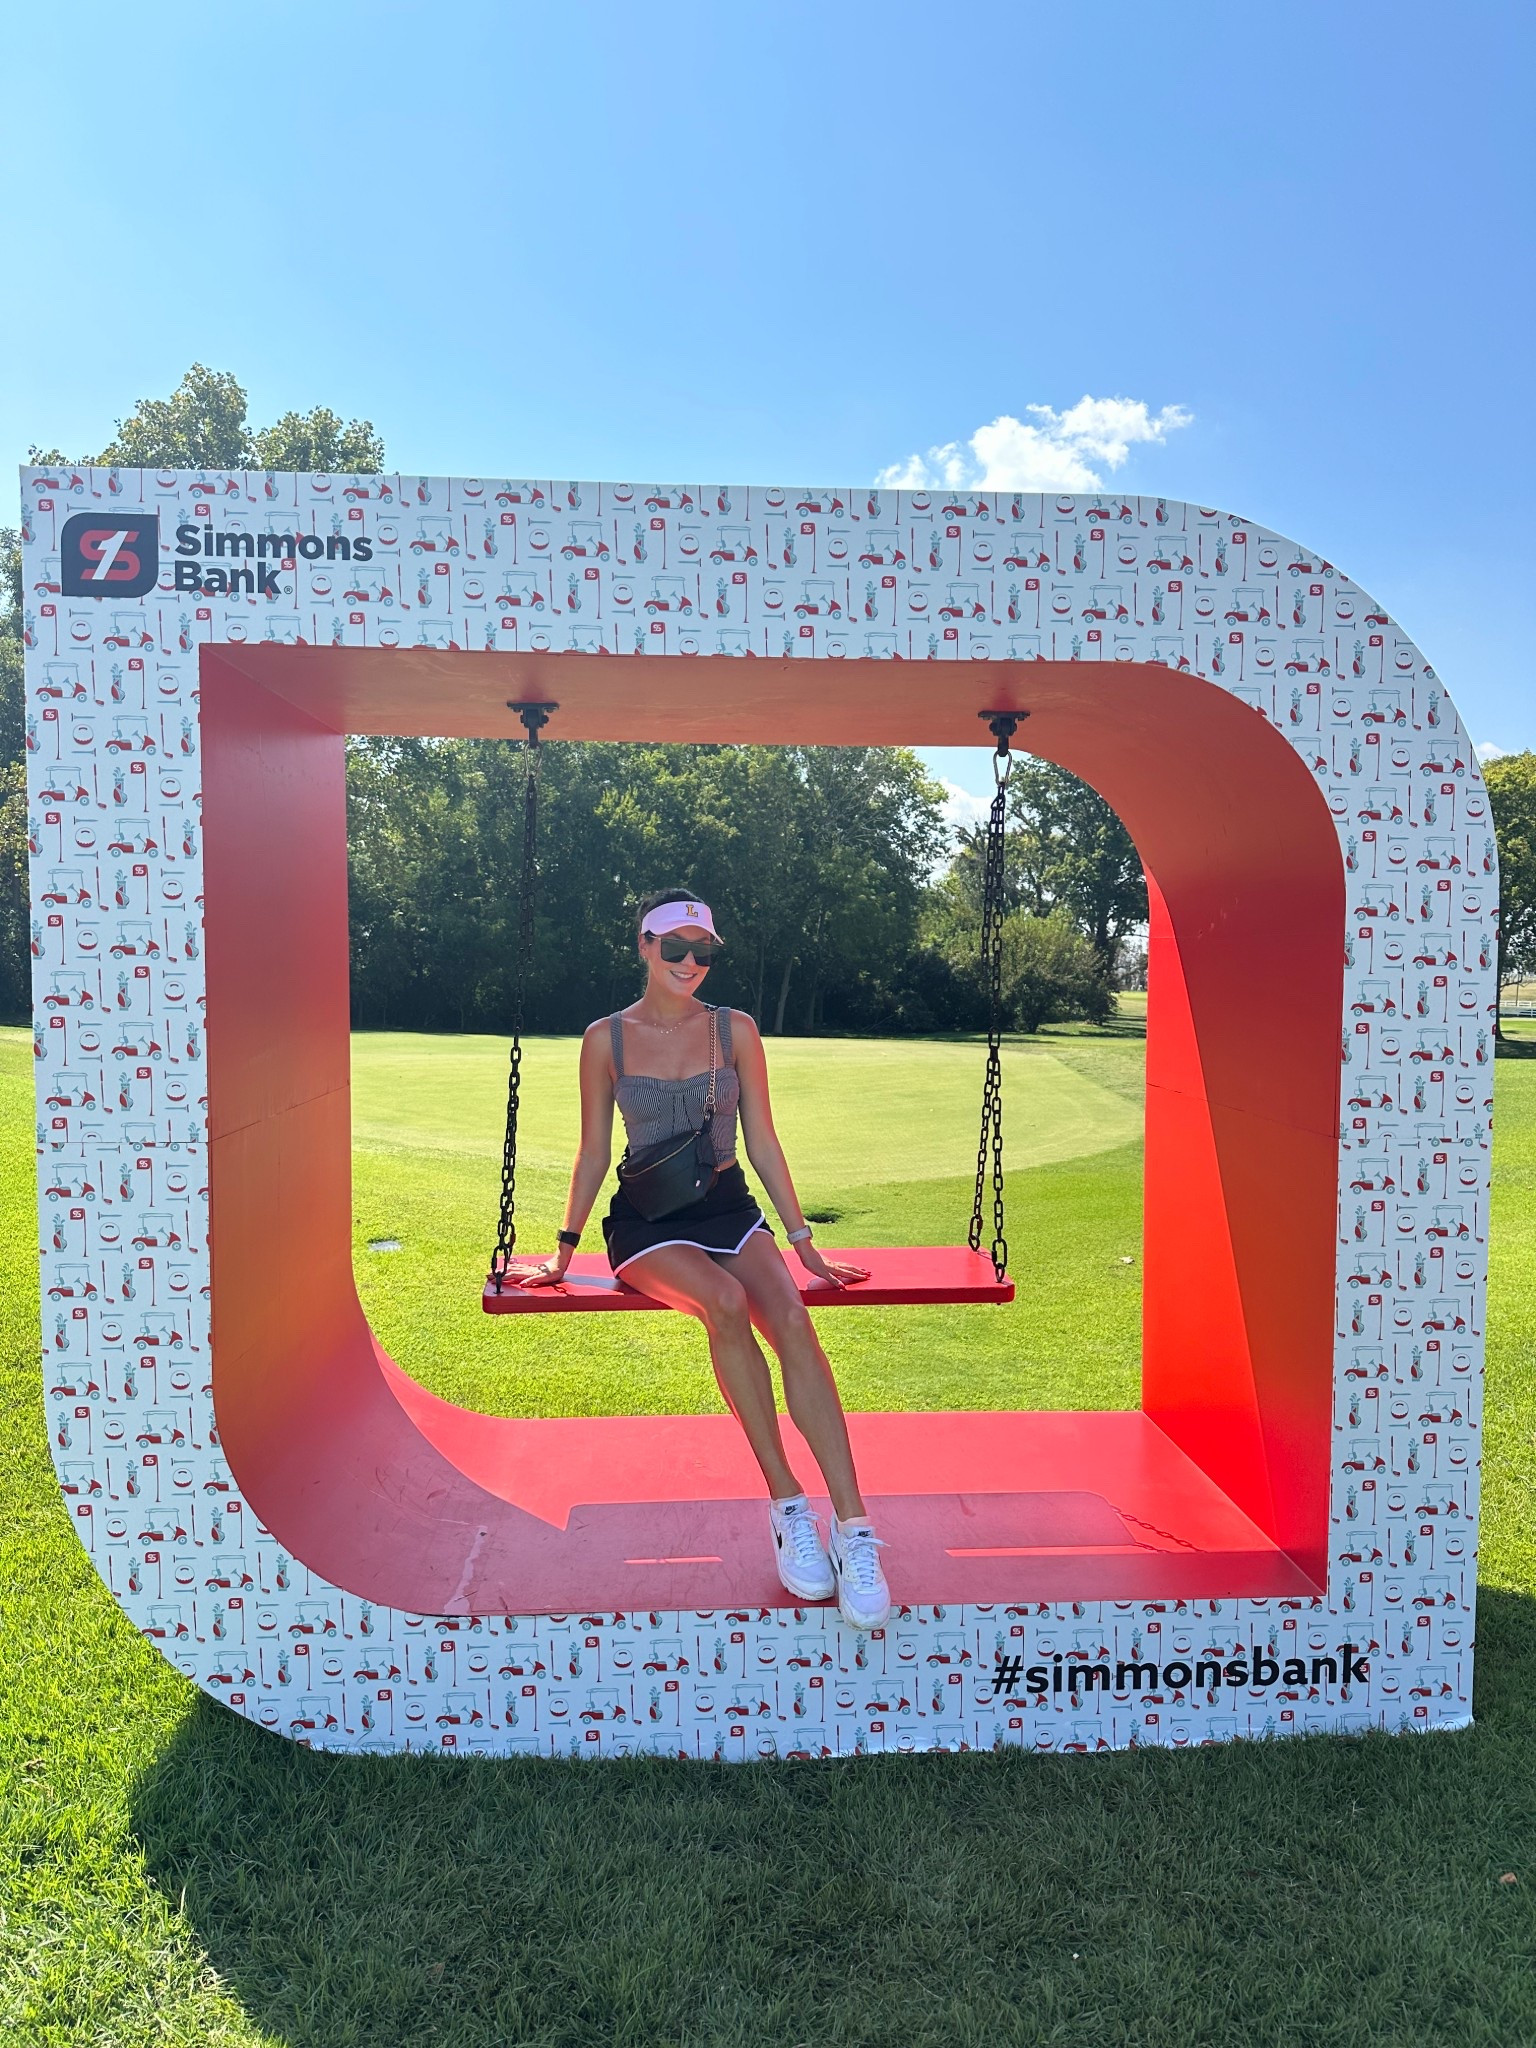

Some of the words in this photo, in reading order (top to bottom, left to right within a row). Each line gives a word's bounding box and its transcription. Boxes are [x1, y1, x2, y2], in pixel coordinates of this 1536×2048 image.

[174, 523, 374, 562] Simmons
[686, 904, 699, 918] L
[991, 1643, 1369, 1695] #simmonsbank
